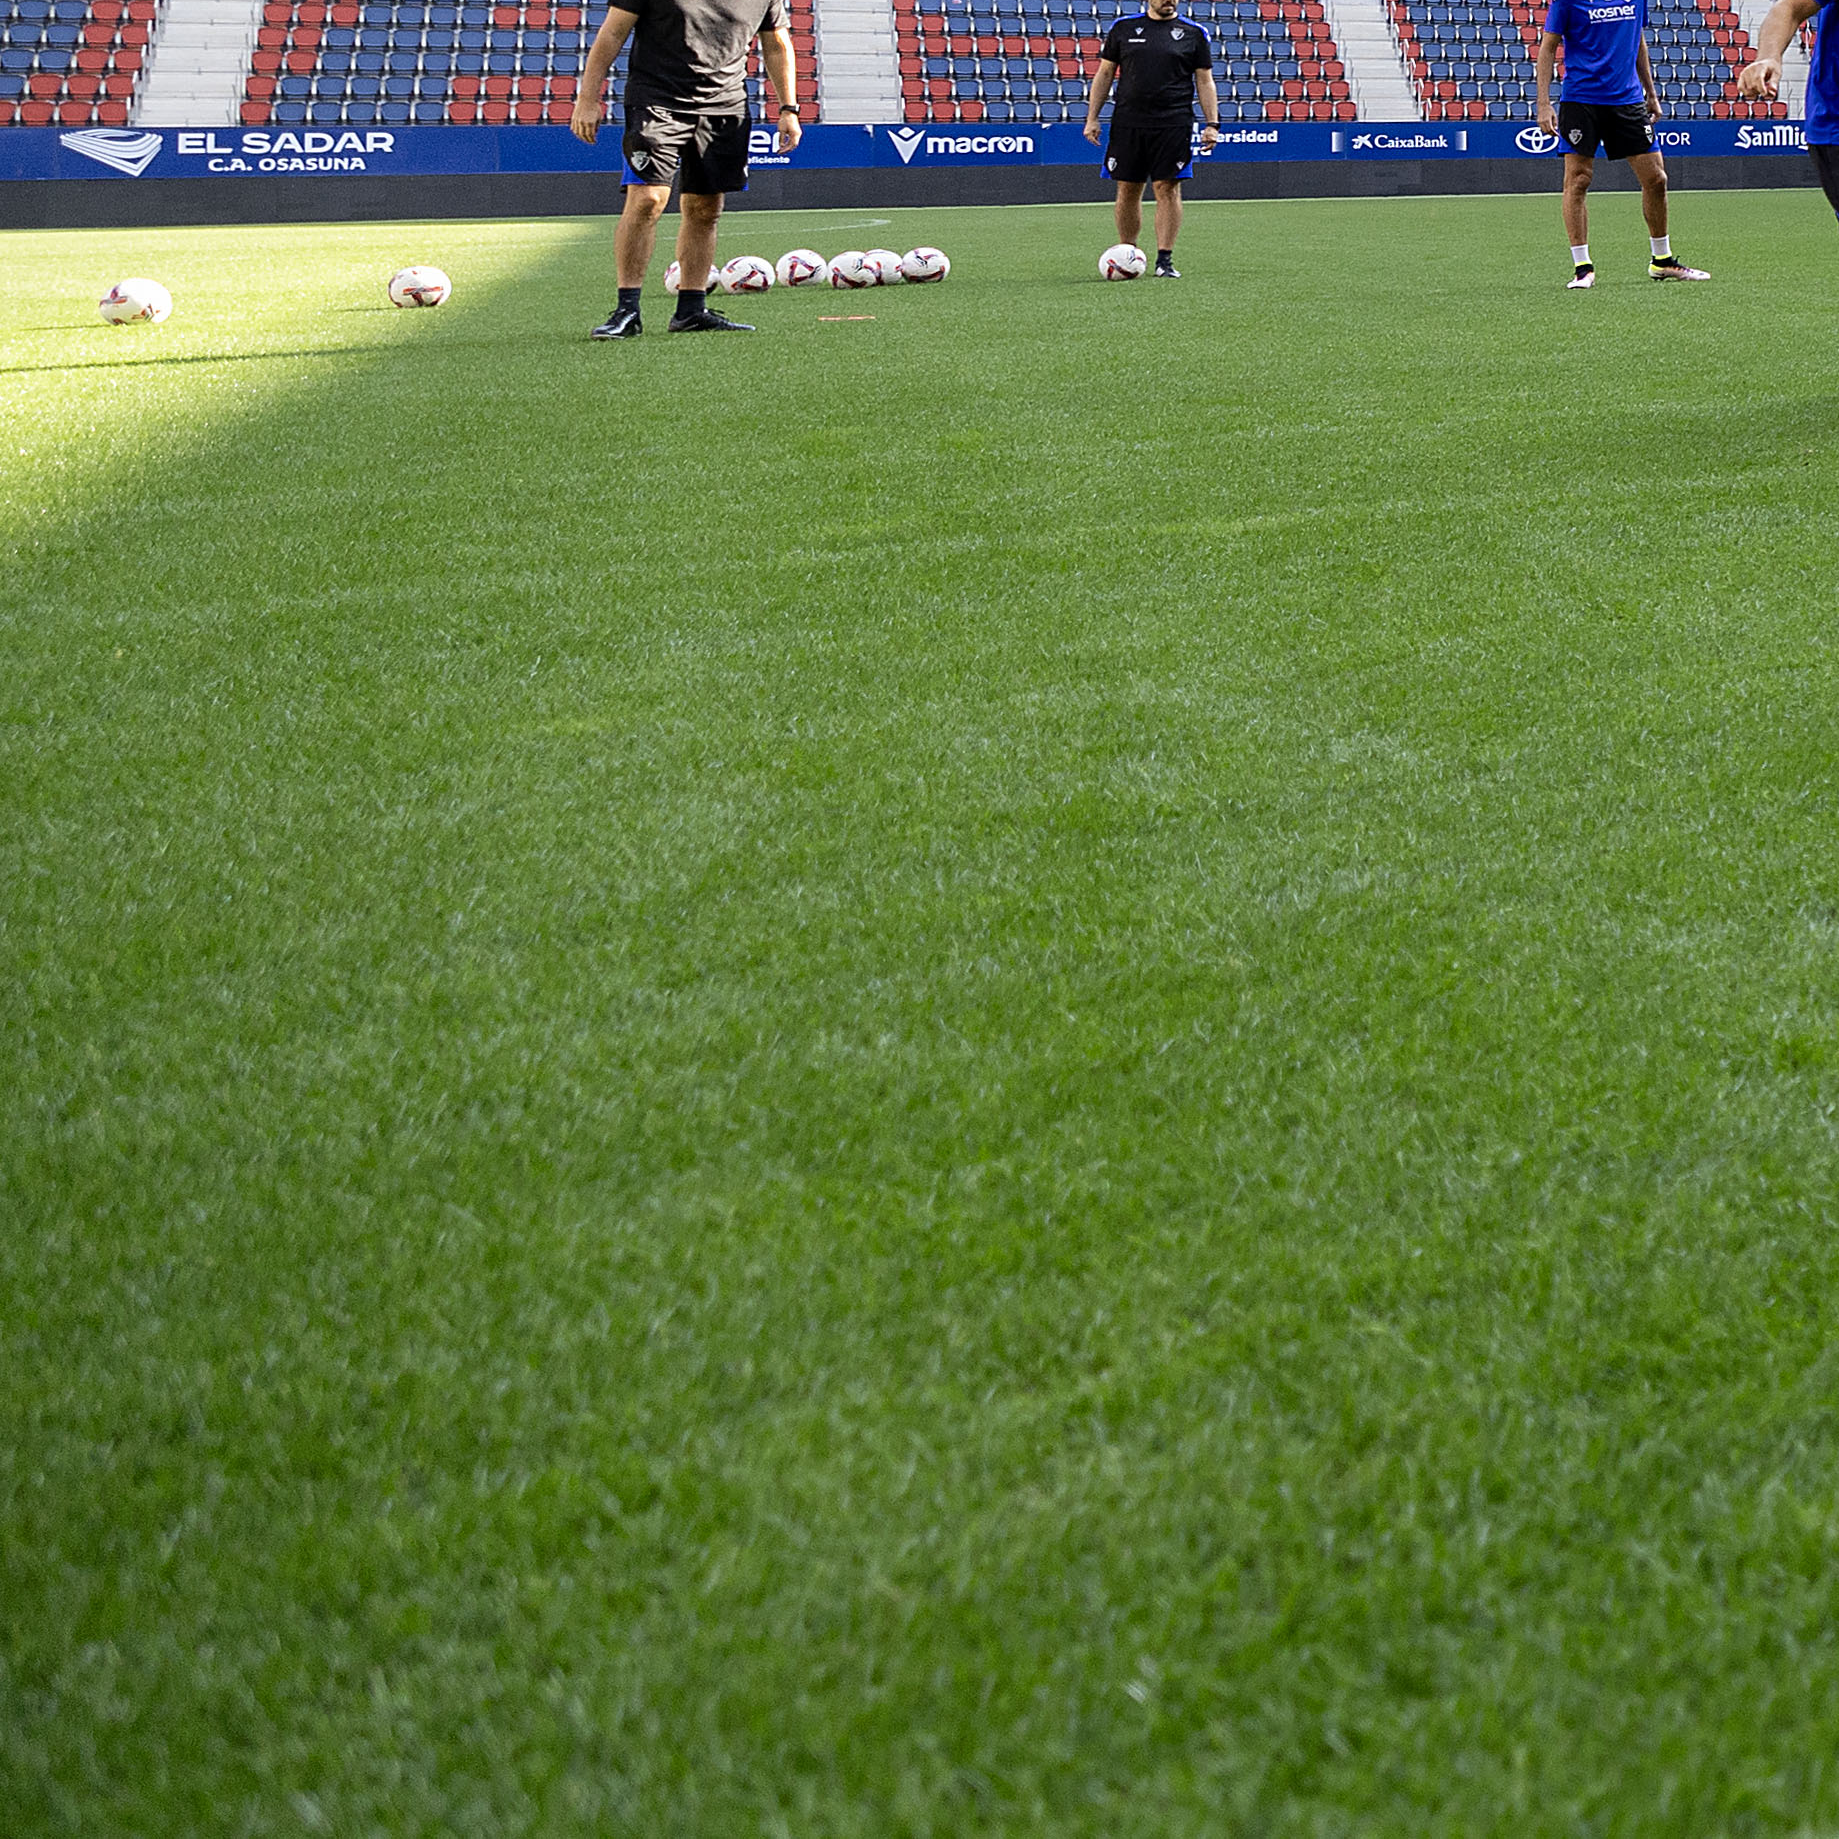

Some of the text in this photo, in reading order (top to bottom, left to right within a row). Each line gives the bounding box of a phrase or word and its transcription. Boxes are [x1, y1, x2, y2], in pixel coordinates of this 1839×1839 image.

[177, 132, 395, 154] EL SADAR
[926, 136, 1034, 154] macron
[1374, 134, 1448, 149] CaixaBank
[208, 157, 366, 171] C.A. OSASUNA
